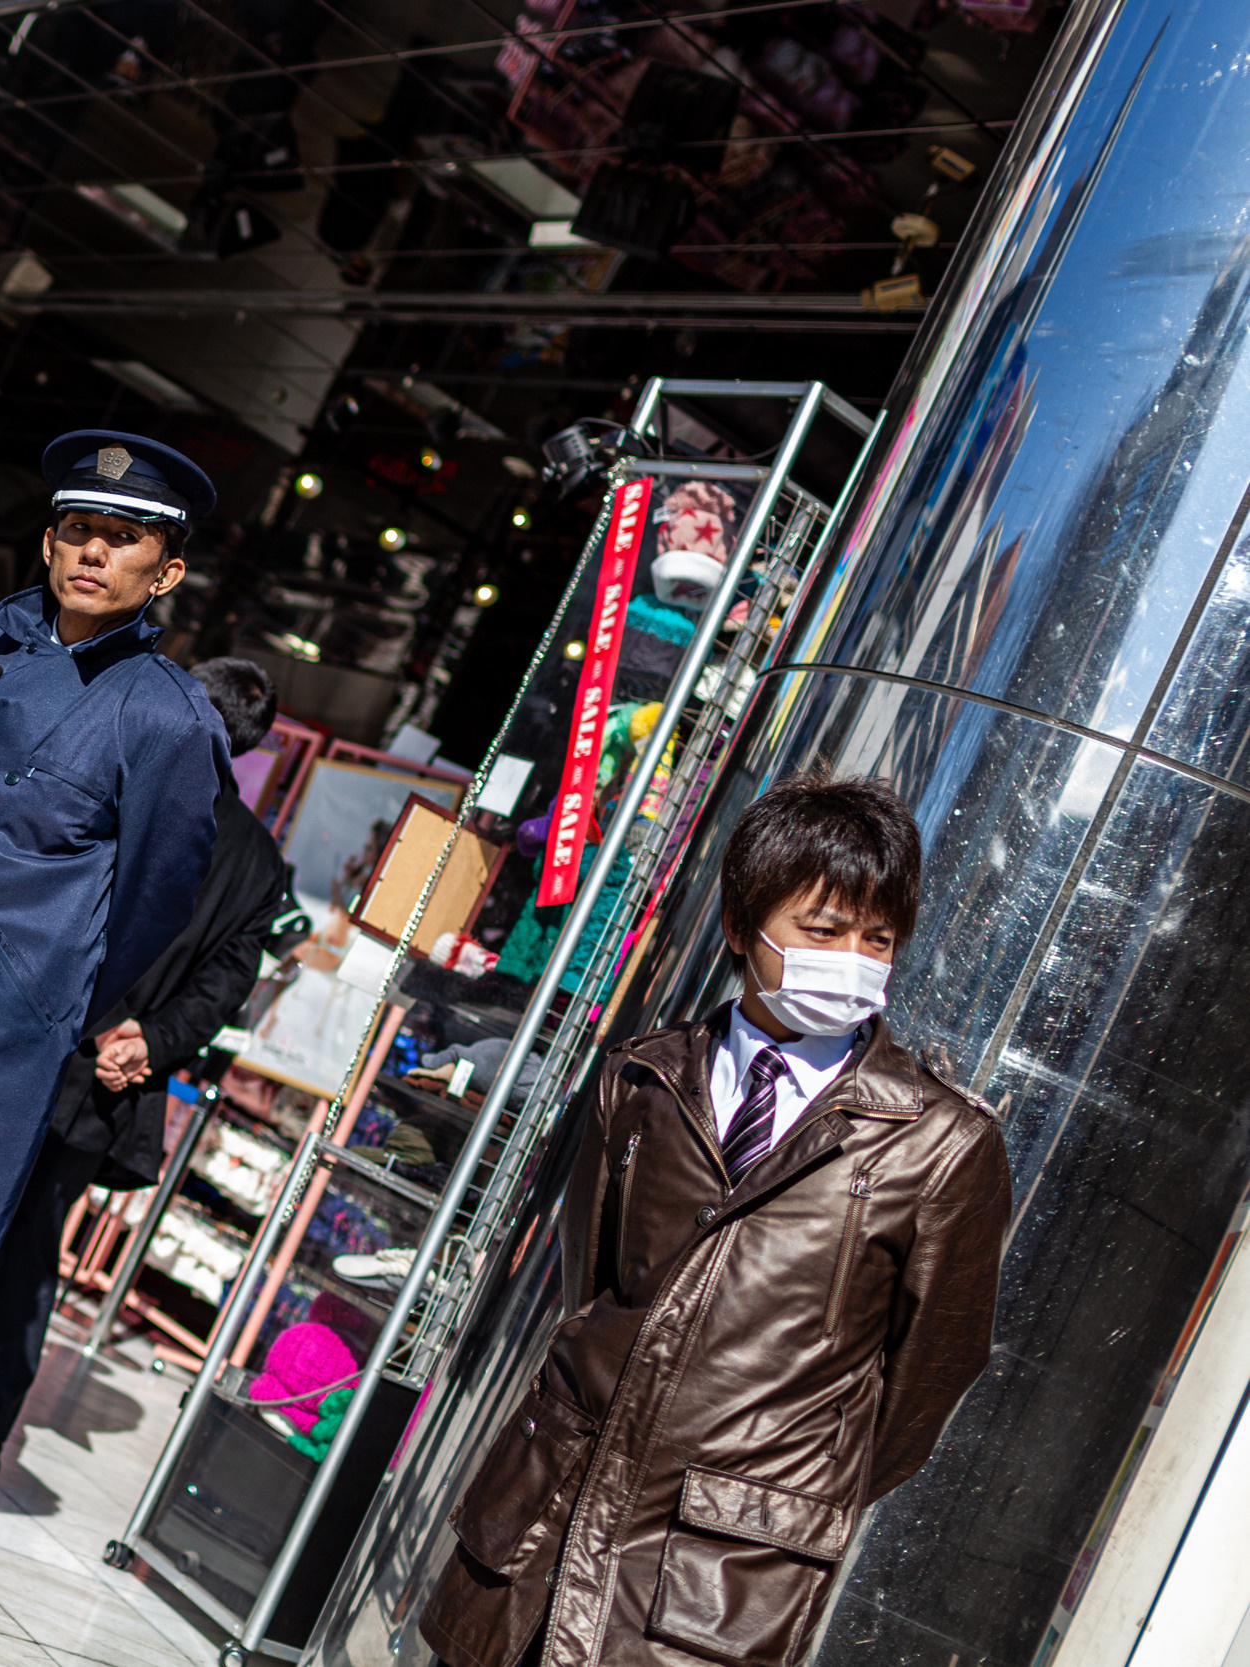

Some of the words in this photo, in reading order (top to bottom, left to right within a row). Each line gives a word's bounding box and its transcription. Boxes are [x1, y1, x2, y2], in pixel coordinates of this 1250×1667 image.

[614, 483, 643, 552] SALE
[594, 583, 623, 653] SALE
[573, 685, 602, 758] SALE
[553, 792, 583, 868] SALE
